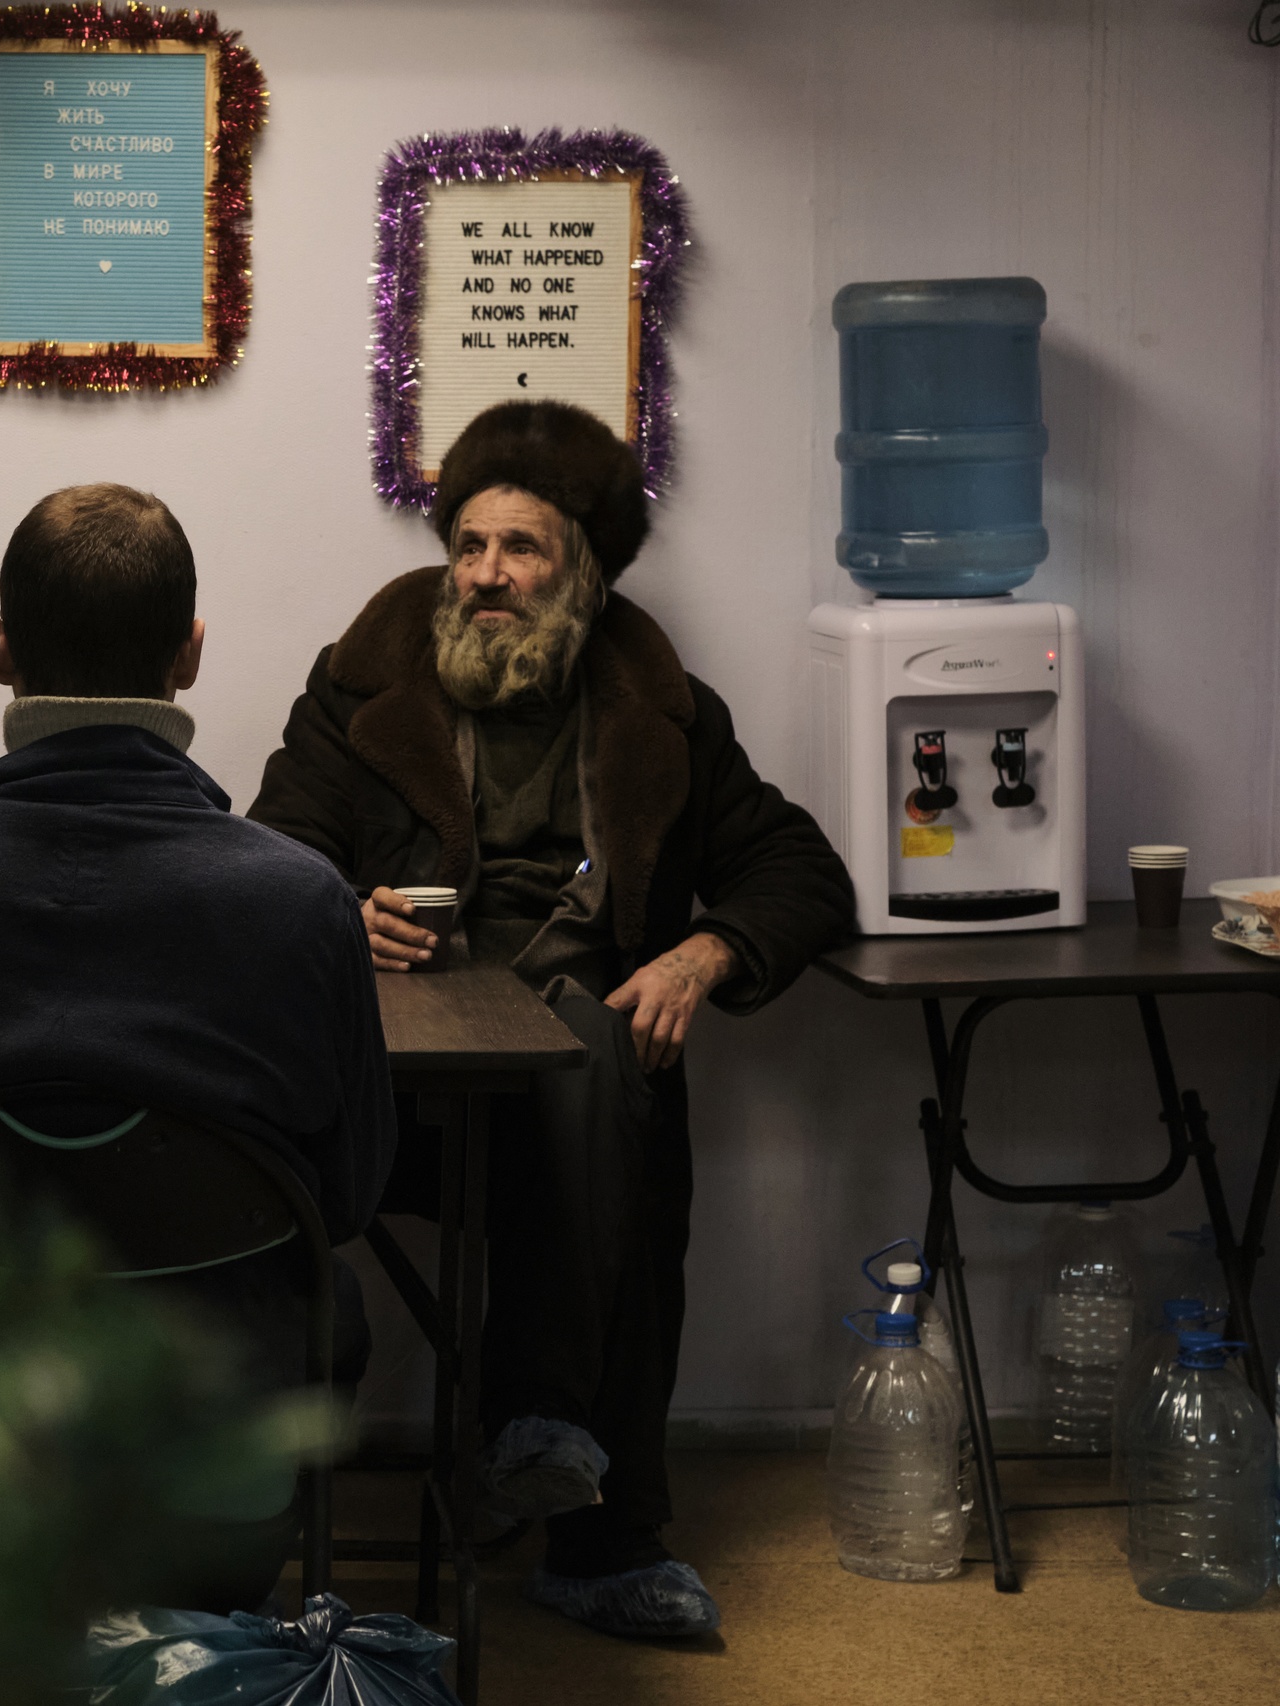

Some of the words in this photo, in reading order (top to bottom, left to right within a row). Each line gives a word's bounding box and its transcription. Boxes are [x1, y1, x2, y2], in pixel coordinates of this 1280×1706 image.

[43, 80, 55, 96] Я
[87, 80, 132, 97] ХОЧУ
[57, 107, 105, 125] ЖИТЬ
[70, 135, 175, 153] СЧАСТЛИВО
[43, 163, 55, 180] В
[73, 163, 124, 181] МИРЕ
[73, 190, 159, 208] КОТОРОГО
[43, 218, 66, 235] НЕ
[82, 218, 170, 236] ПОНИМАЮ
[461, 221, 484, 238] WE
[501, 221, 533, 238] ALL
[549, 221, 595, 238] KNOW
[471, 249, 513, 266] WHAT
[523, 249, 604, 266] HAPPENED
[461, 277, 495, 294] AND
[510, 277, 532, 294] NO
[542, 277, 575, 294] ONE
[471, 304, 526, 322] KNOWS
[538, 304, 579, 322] WHAT
[461, 331, 496, 349] WILL
[507, 331, 575, 349] HAPPEN.
